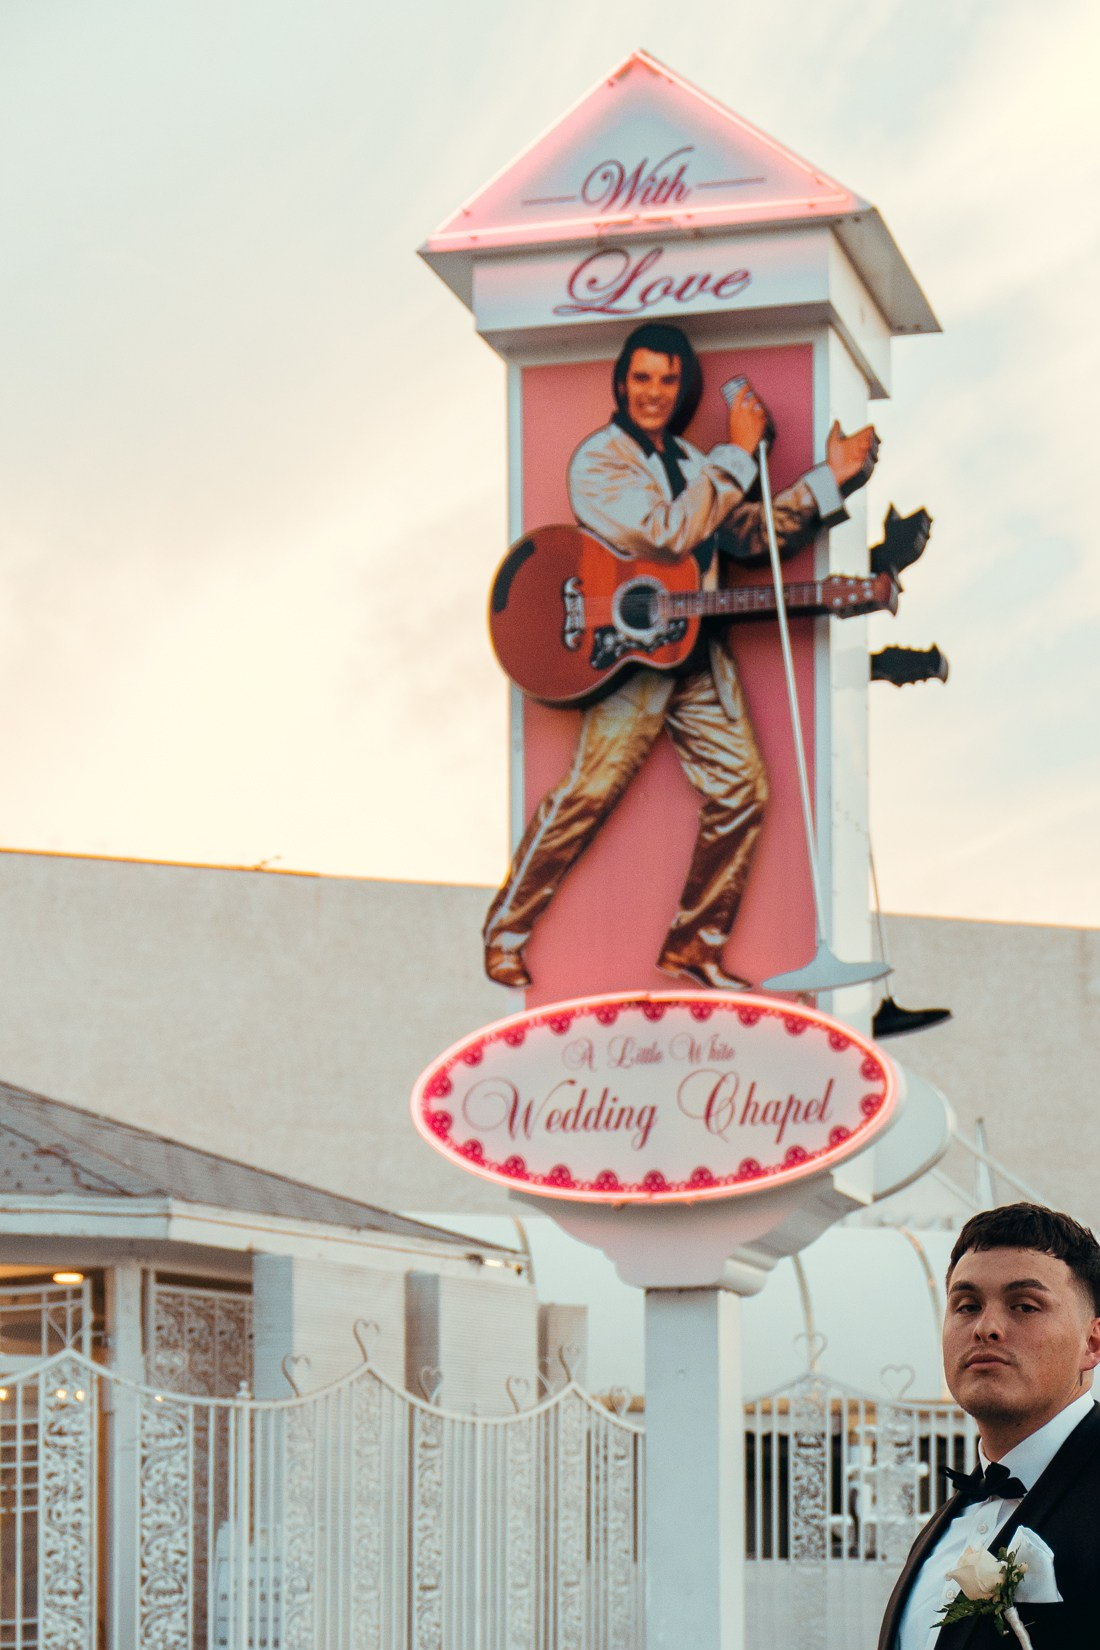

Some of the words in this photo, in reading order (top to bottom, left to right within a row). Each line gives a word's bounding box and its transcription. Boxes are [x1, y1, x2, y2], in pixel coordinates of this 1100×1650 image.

[581, 146, 695, 214] With
[552, 246, 753, 317] Love
[562, 1037, 598, 1073] A
[607, 1034, 665, 1070] Little
[669, 1031, 737, 1065] White
[462, 1076, 659, 1151] Wedding
[676, 1067, 837, 1146] Chapel
